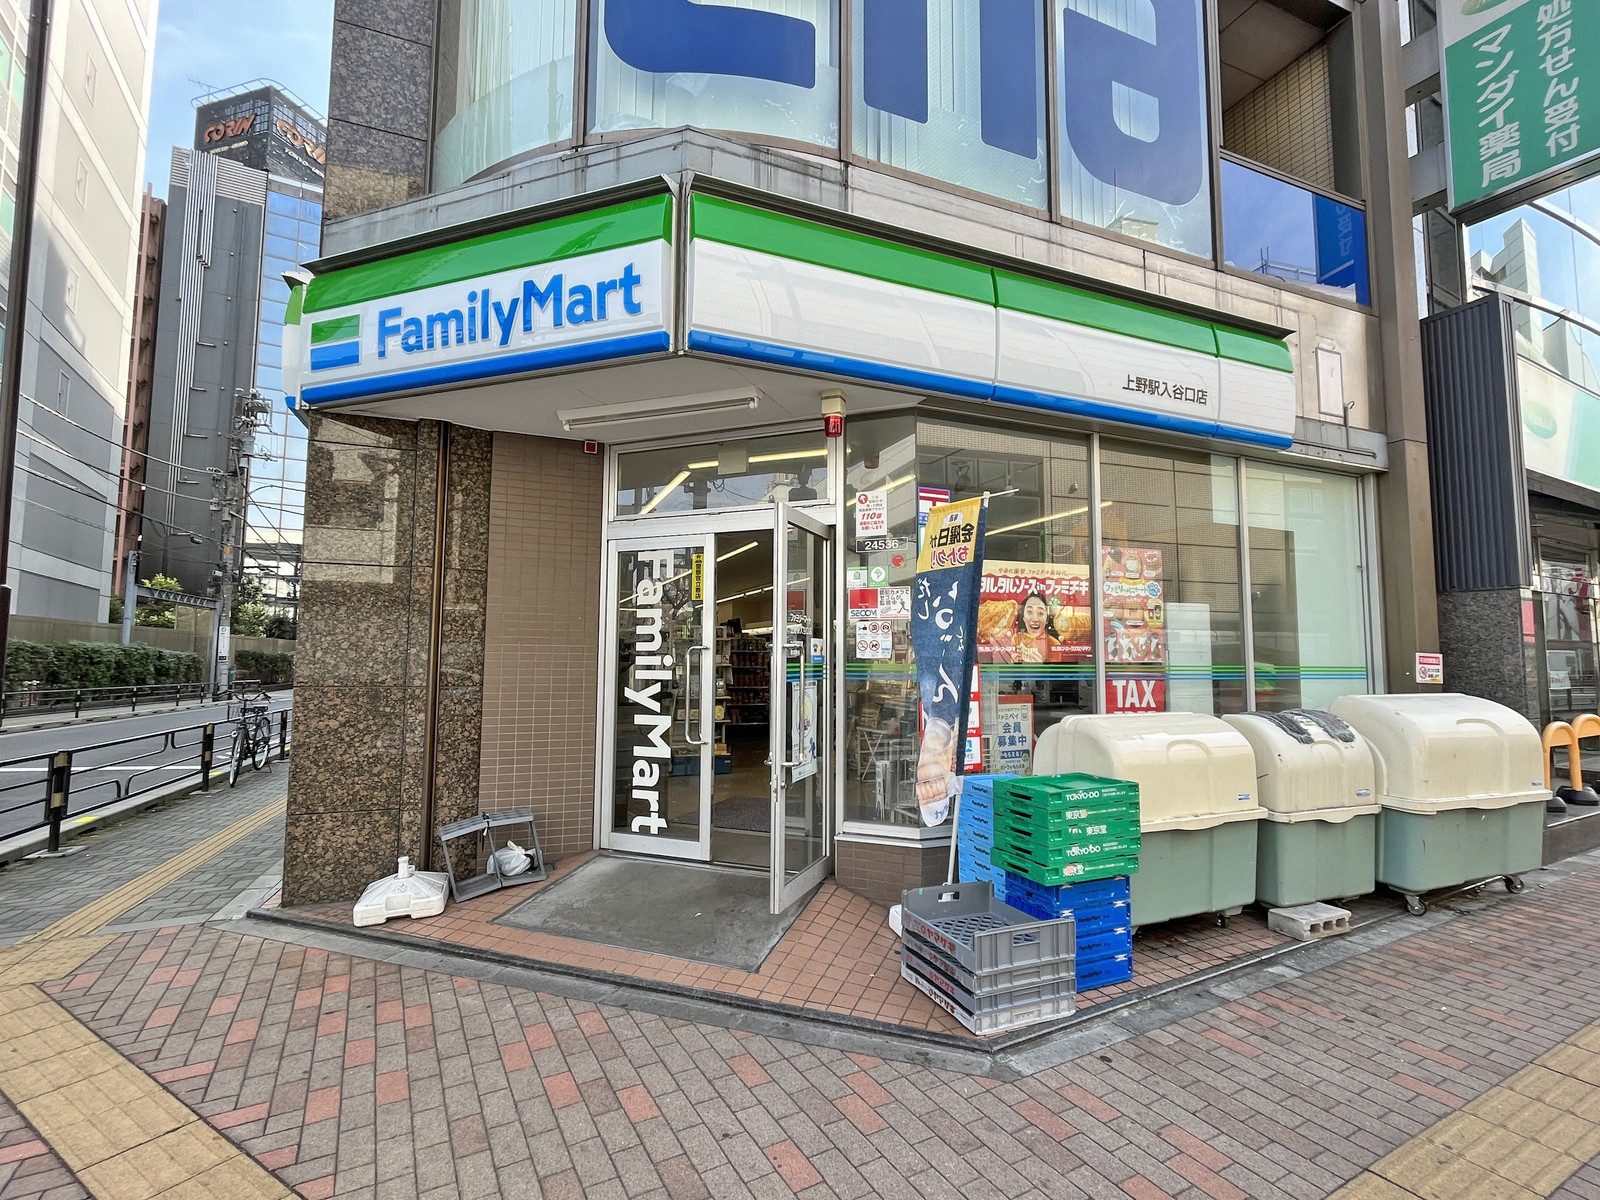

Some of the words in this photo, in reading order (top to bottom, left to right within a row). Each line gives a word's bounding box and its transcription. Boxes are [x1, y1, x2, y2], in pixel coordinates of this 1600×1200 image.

[1536, 0, 1581, 158] 処方せん受付
[1472, 24, 1522, 188] マンダイ薬局
[377, 262, 643, 361] FamilyMart
[1122, 374, 1208, 405] 上野駅入谷口店
[865, 540, 899, 550] 24536
[850, 609, 878, 617] SECOM
[624, 549, 675, 835] FamilyMart
[1112, 680, 1157, 708] TAX
[998, 735, 1027, 747] 募集中
[1002, 722, 1022, 734] 会員
[1065, 790, 1100, 801] TOKYO-DO
[926, 928, 956, 953] ヤマザキ
